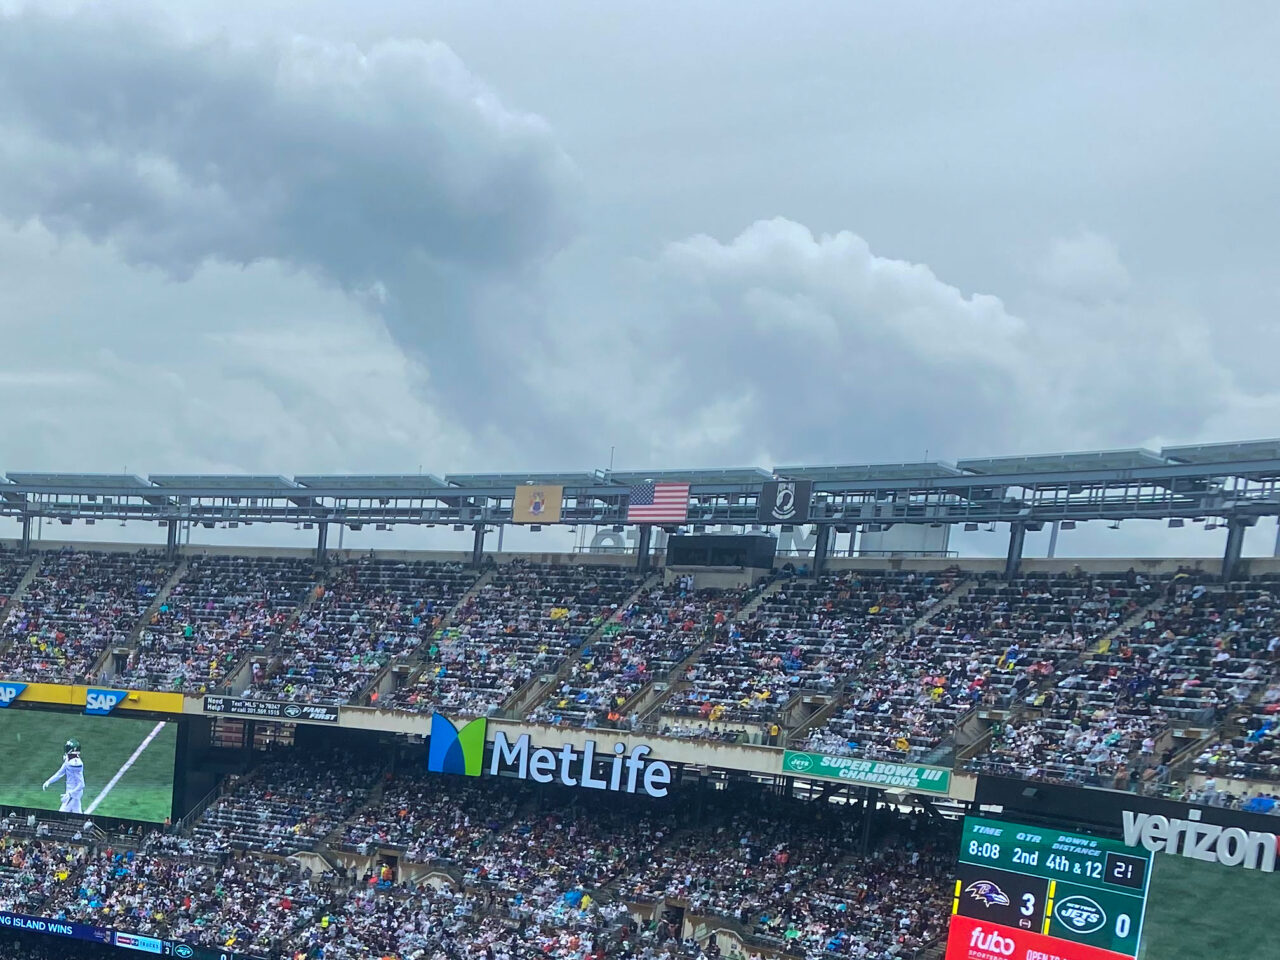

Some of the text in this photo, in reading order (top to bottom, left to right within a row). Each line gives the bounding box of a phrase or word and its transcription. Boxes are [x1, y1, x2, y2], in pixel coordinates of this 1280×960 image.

[86, 694, 117, 711] SAP
[490, 731, 671, 798] MetLife
[820, 756, 943, 782] SUPER BOWL III
[838, 769, 920, 788] CHAMPIONS
[972, 824, 1003, 837] TIME
[1016, 832, 1042, 844] QTR
[968, 840, 1000, 859] 8:08
[1052, 842, 1102, 857] DISTANCE
[1058, 835, 1089, 846] DOWN
[1122, 808, 1277, 873] verizon
[1012, 848, 1038, 866] 2nd
[1046, 853, 1103, 878] 4th & 12
[1114, 862, 1132, 878] 21
[1020, 892, 1036, 916] 3
[1060, 907, 1100, 923] JETS
[12, 917, 46, 930] ISLAND
[48, 922, 73, 935] WINS
[1115, 914, 1131, 938] 0
[970, 926, 1016, 956] fubo
